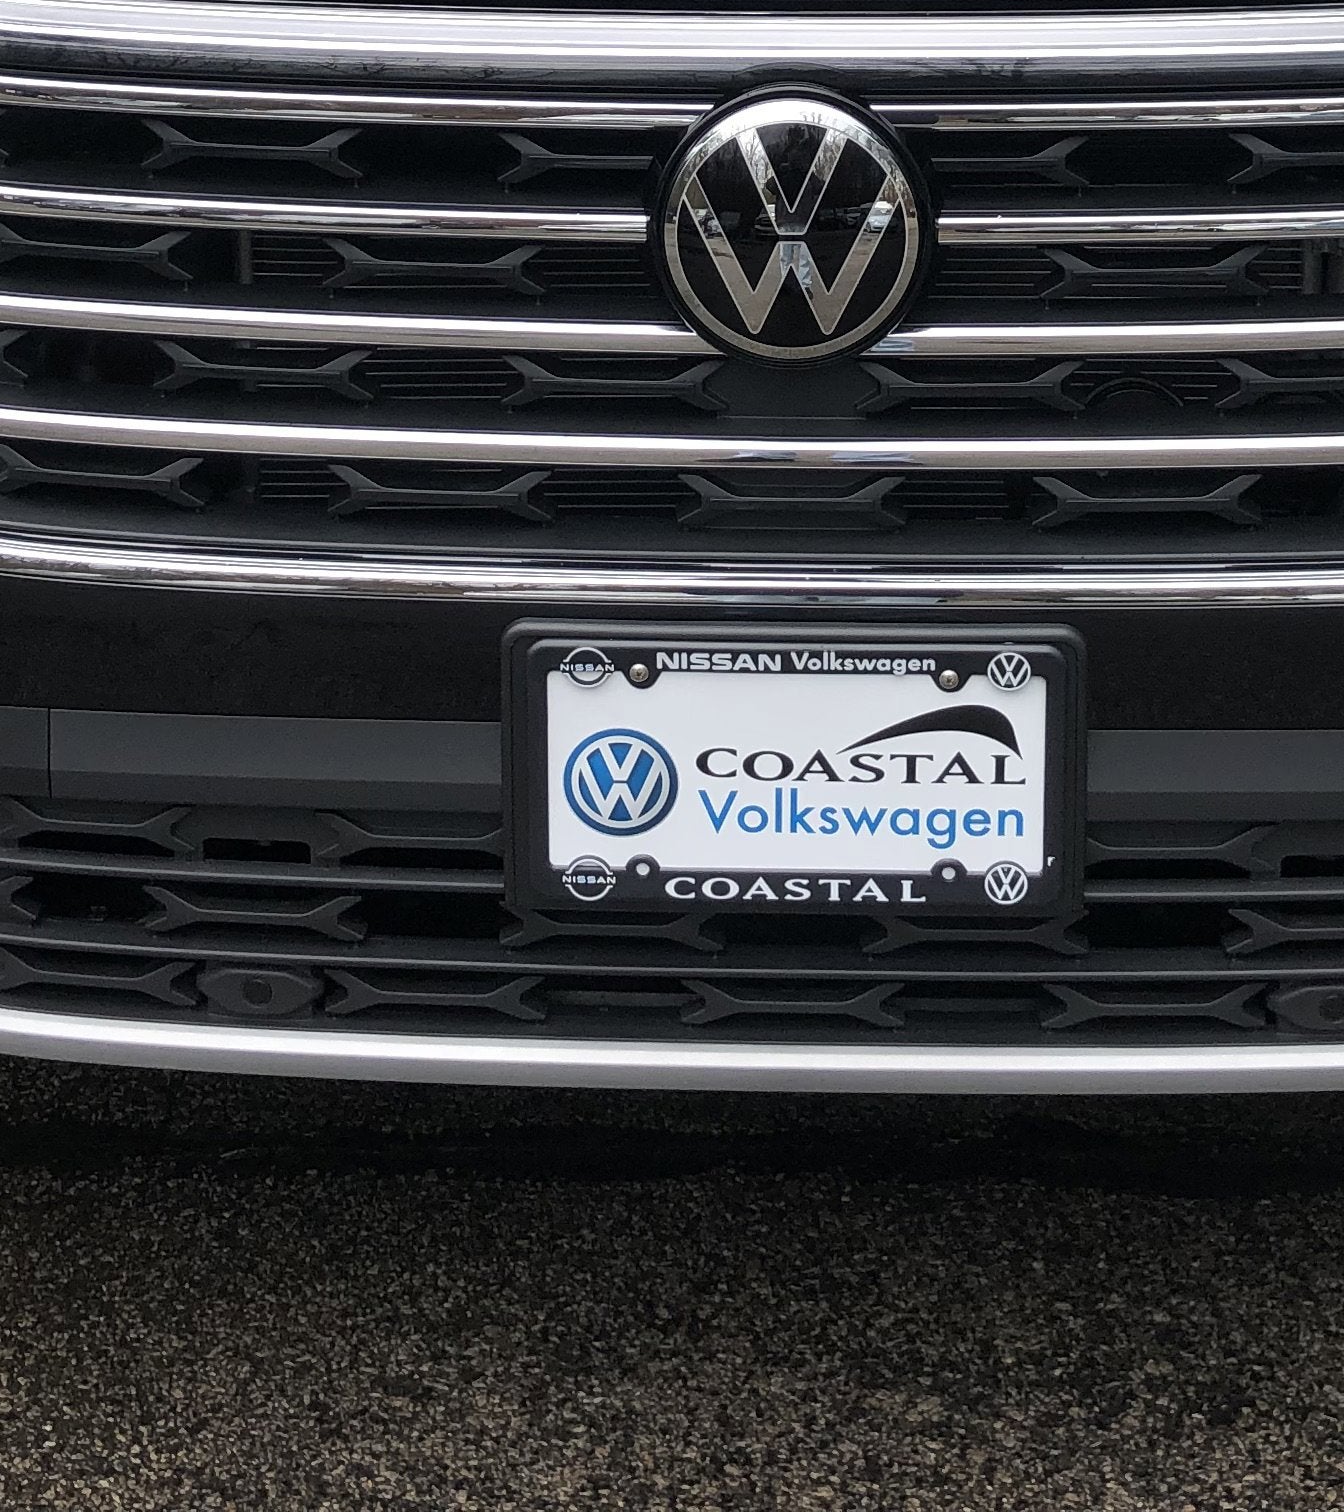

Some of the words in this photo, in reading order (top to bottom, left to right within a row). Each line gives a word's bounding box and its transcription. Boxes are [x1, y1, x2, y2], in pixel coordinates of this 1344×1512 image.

[559, 662, 615, 672] NISSAN
[656, 651, 782, 671] NISSAN
[790, 651, 936, 675] Volkswagen
[696, 748, 1027, 785] COASTAL
[697, 787, 1025, 849] Volkswagen
[562, 873, 616, 884] NISSAN
[664, 875, 927, 903] COASTAL
